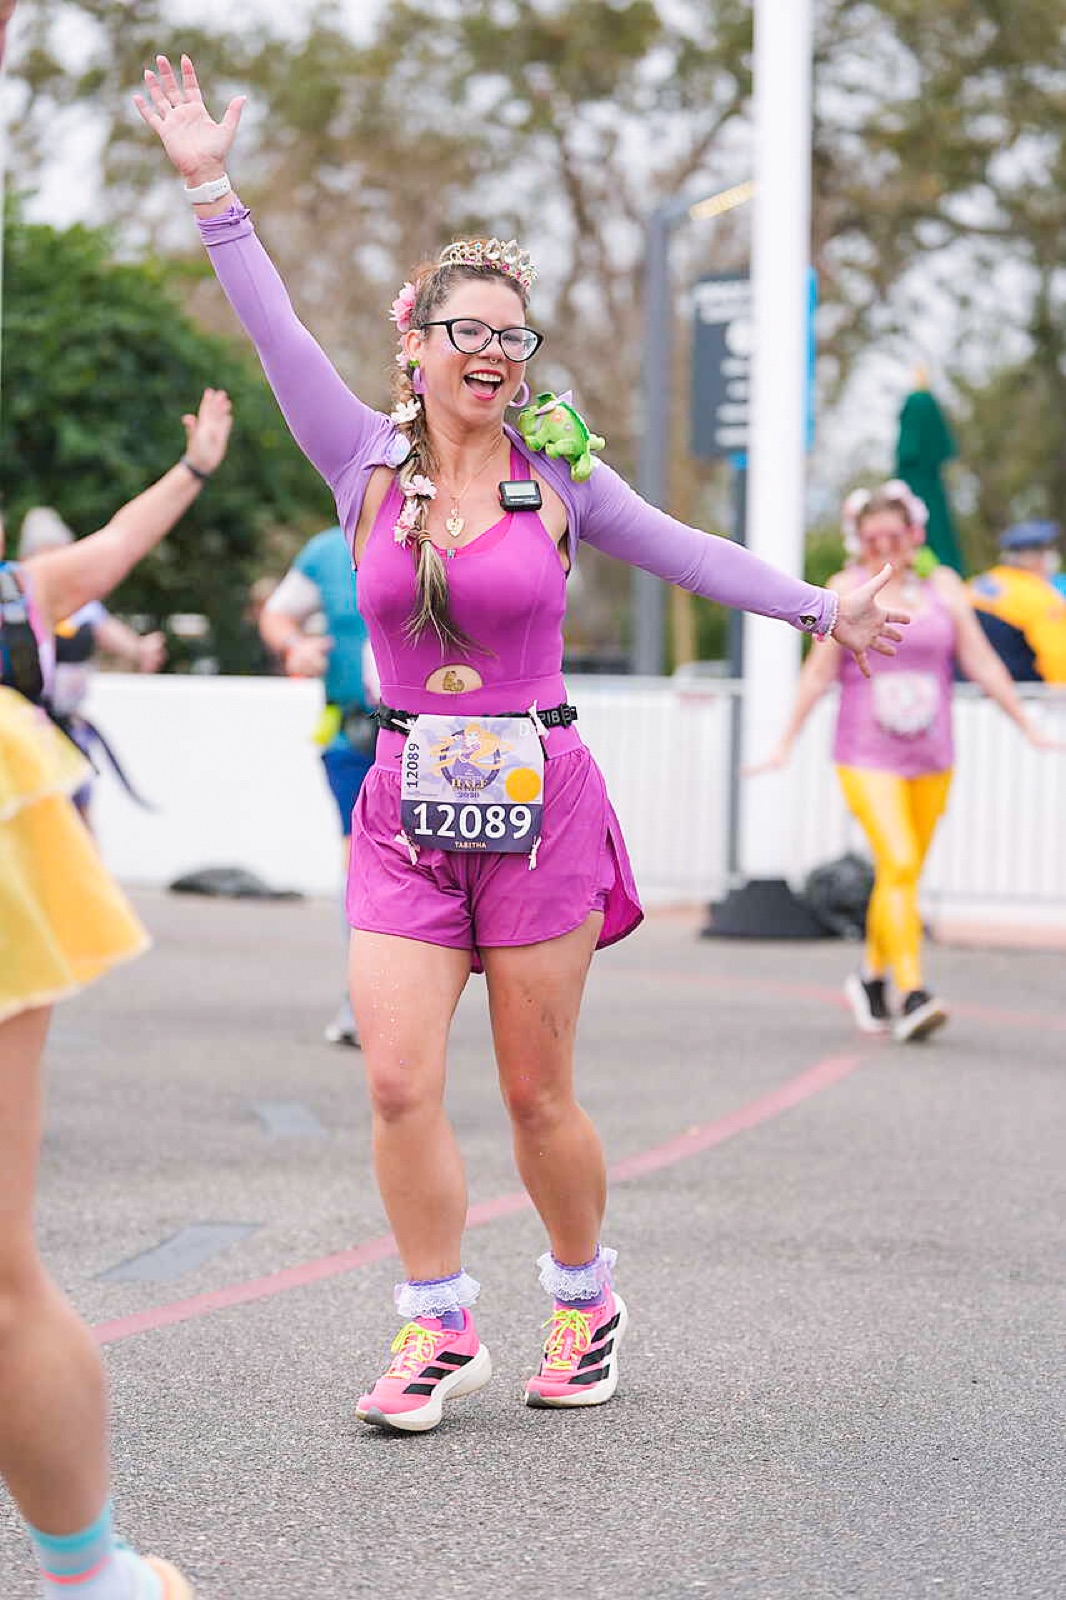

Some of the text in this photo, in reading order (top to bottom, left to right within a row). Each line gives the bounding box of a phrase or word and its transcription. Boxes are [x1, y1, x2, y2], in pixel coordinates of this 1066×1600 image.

[406, 743, 420, 789] 12089
[413, 802, 532, 839] 12089
[455, 841, 487, 850] TABITHA
